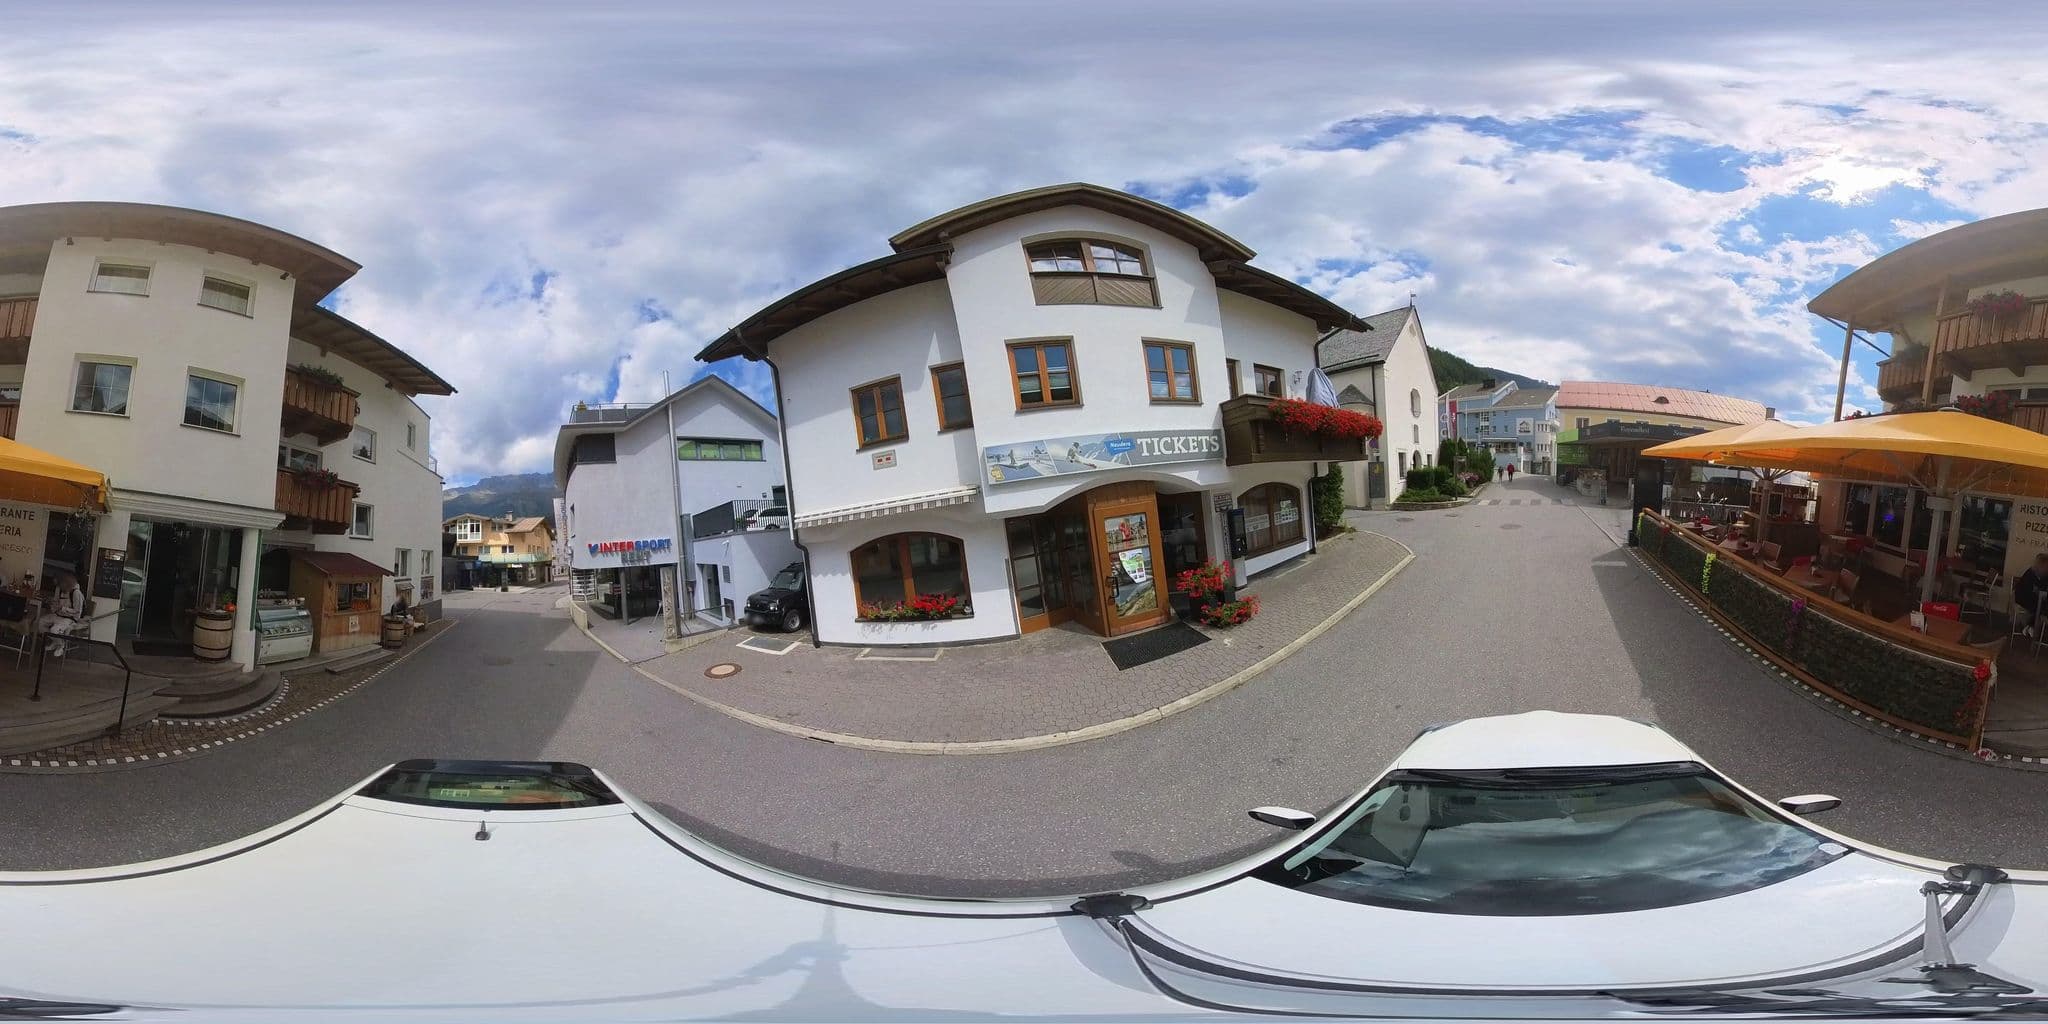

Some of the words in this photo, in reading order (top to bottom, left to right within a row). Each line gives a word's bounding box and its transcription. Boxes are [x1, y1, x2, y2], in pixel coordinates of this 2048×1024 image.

[1136, 435, 1219, 457] TICKETS
[0, 508, 35, 520] RANTE
[2025, 521, 2048, 534] PIZZ
[600, 539, 672, 553] INTERSPORT
